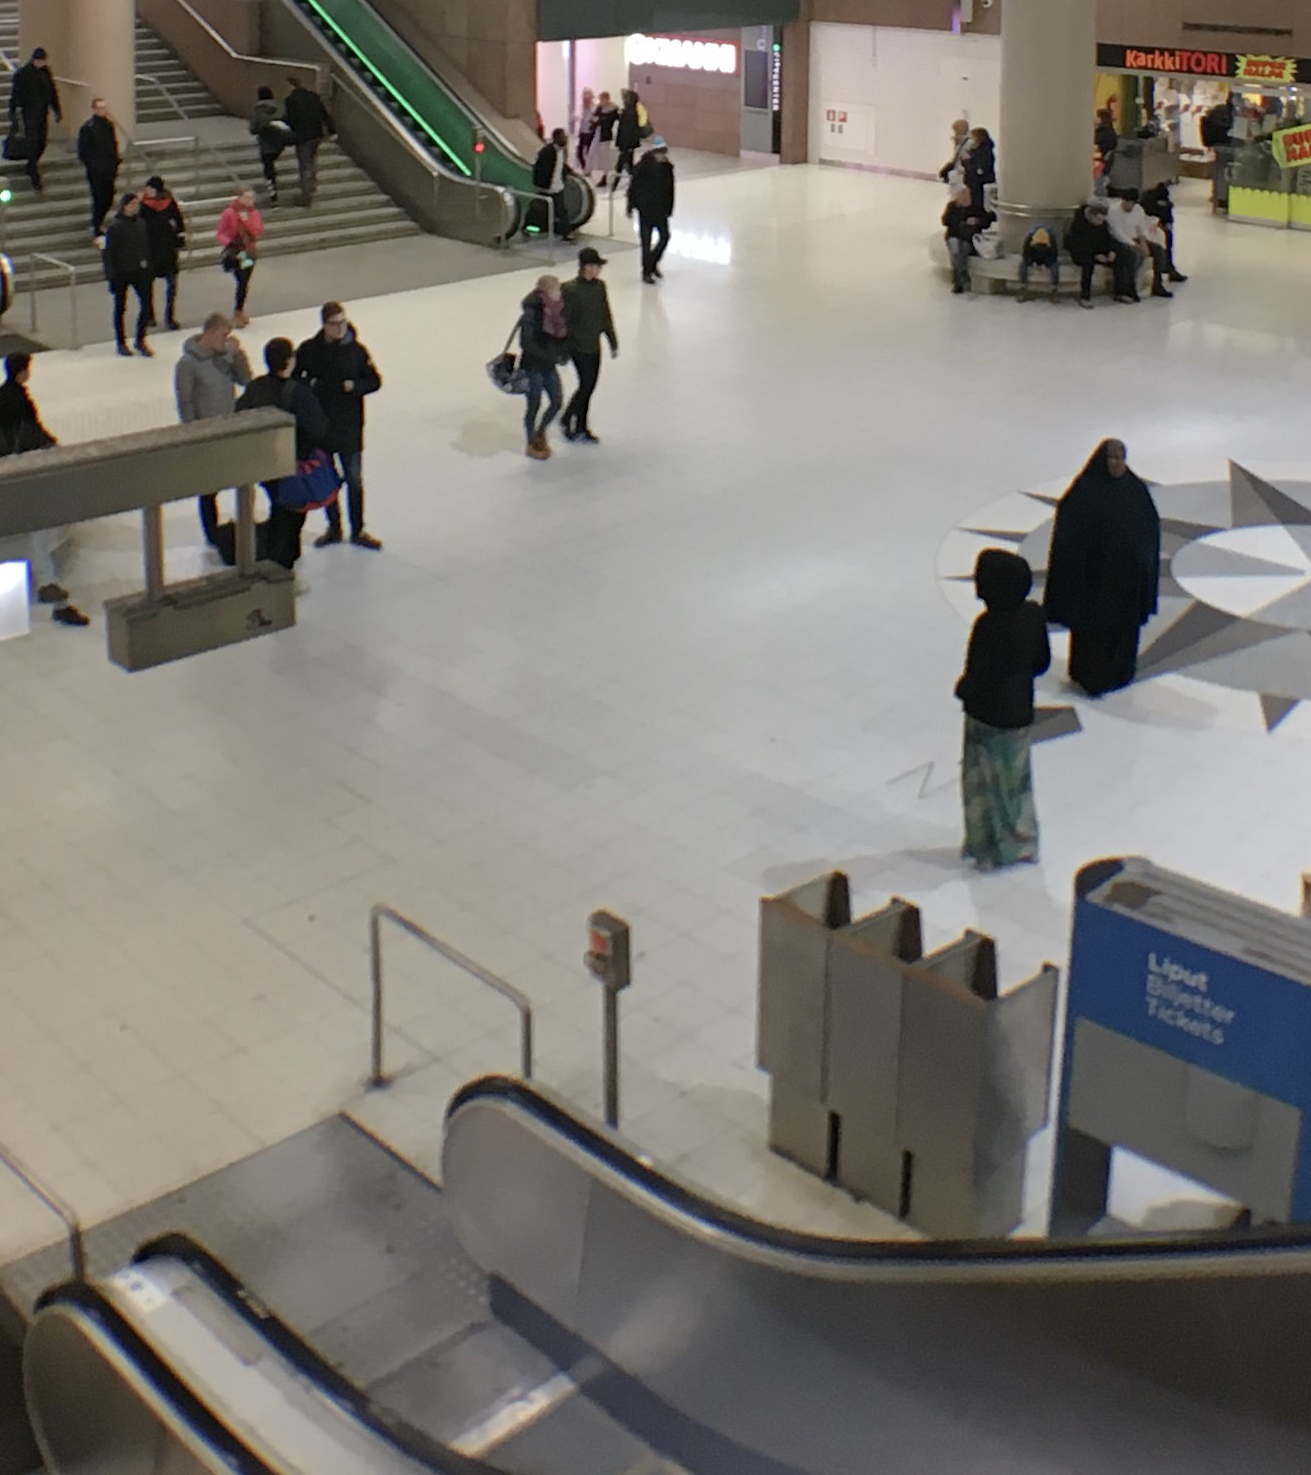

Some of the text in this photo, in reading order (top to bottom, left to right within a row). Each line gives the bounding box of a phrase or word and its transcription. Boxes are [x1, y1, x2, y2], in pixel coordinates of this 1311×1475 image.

[1125, 48, 1227, 75] KarkkiTORI
[1147, 951, 1207, 992] Liput
[1145, 994, 1224, 1045] Tickets
[1146, 973, 1235, 1024] Biljetter
